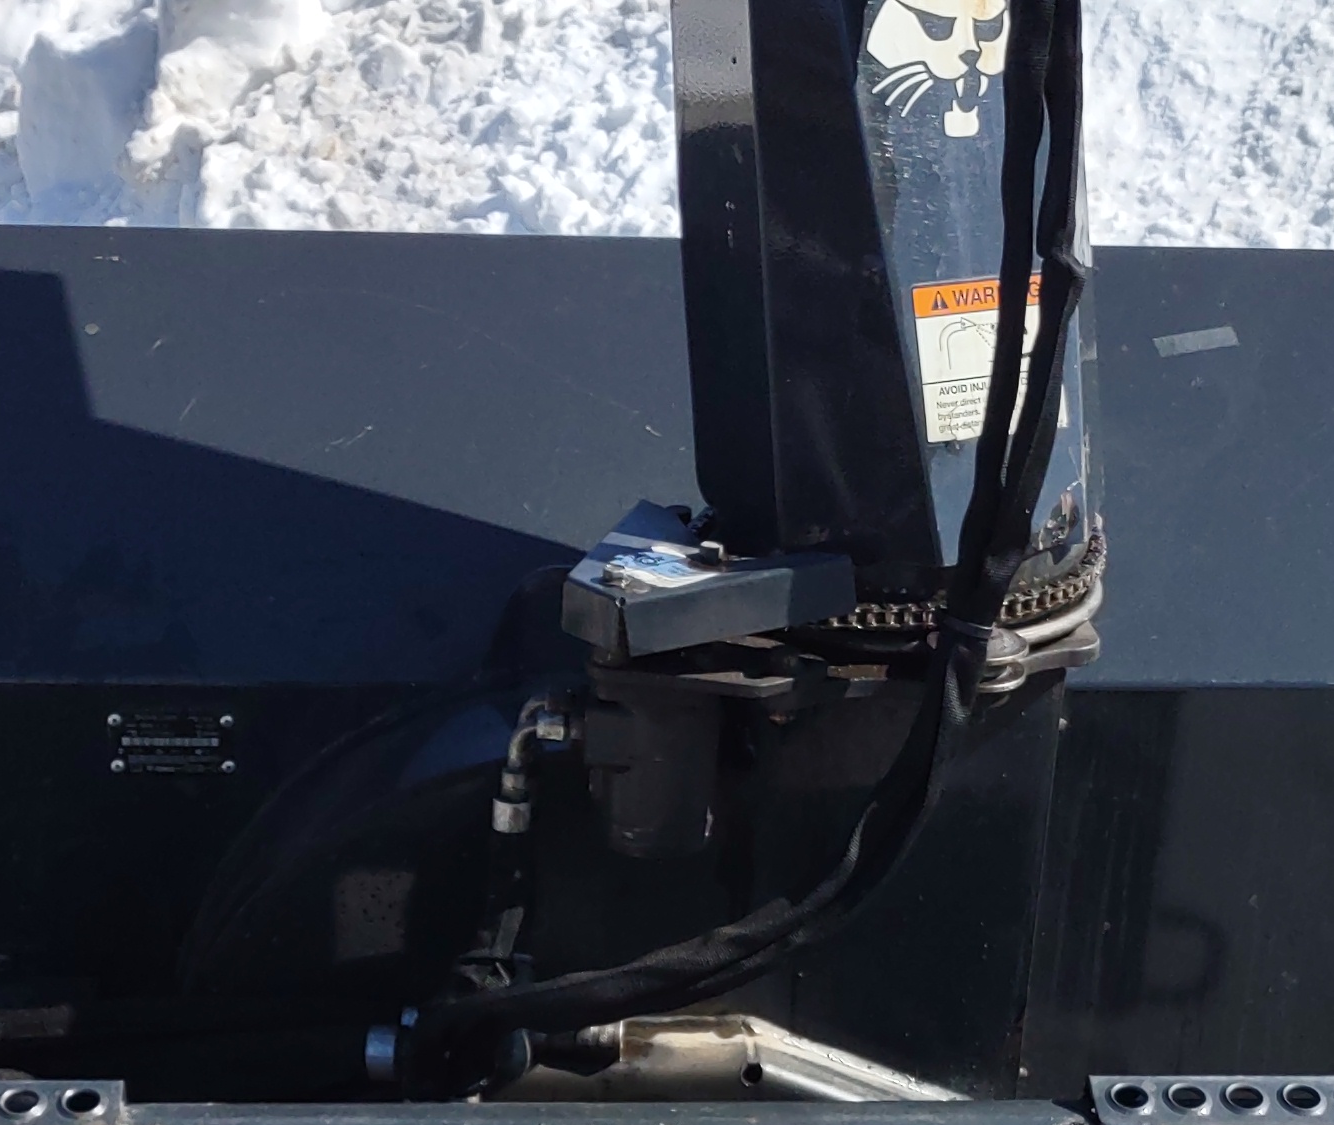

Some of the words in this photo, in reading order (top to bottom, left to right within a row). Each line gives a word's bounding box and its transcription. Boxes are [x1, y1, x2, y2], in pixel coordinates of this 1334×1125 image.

[952, 281, 1040, 307] WARG
[939, 384, 968, 396] AVOID
[936, 400, 959, 409] Never
[960, 397, 981, 407] direct
